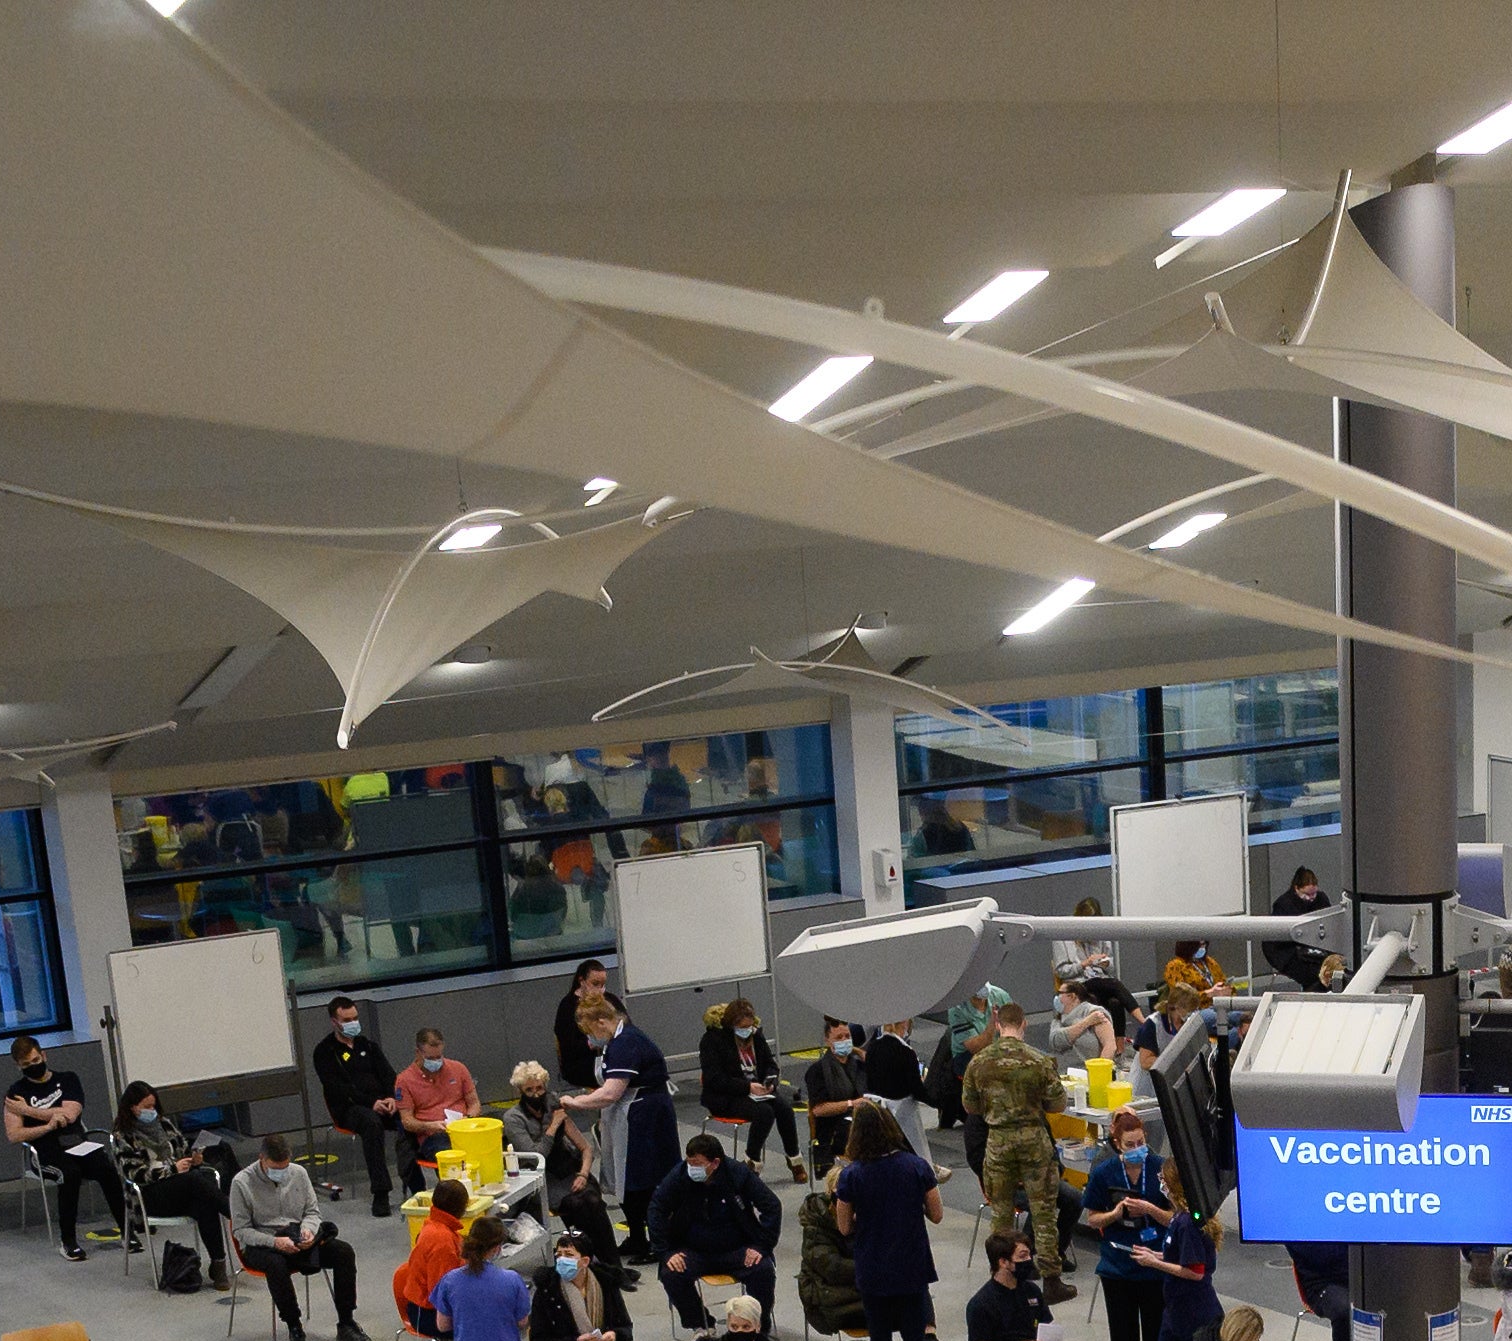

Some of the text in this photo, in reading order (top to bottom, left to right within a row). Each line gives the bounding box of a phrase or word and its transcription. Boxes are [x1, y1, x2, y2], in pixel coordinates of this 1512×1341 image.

[125, 939, 265, 979] 5 6
[1269, 1136, 1491, 1167] Vaccination
[1324, 1186, 1442, 1215] centre
